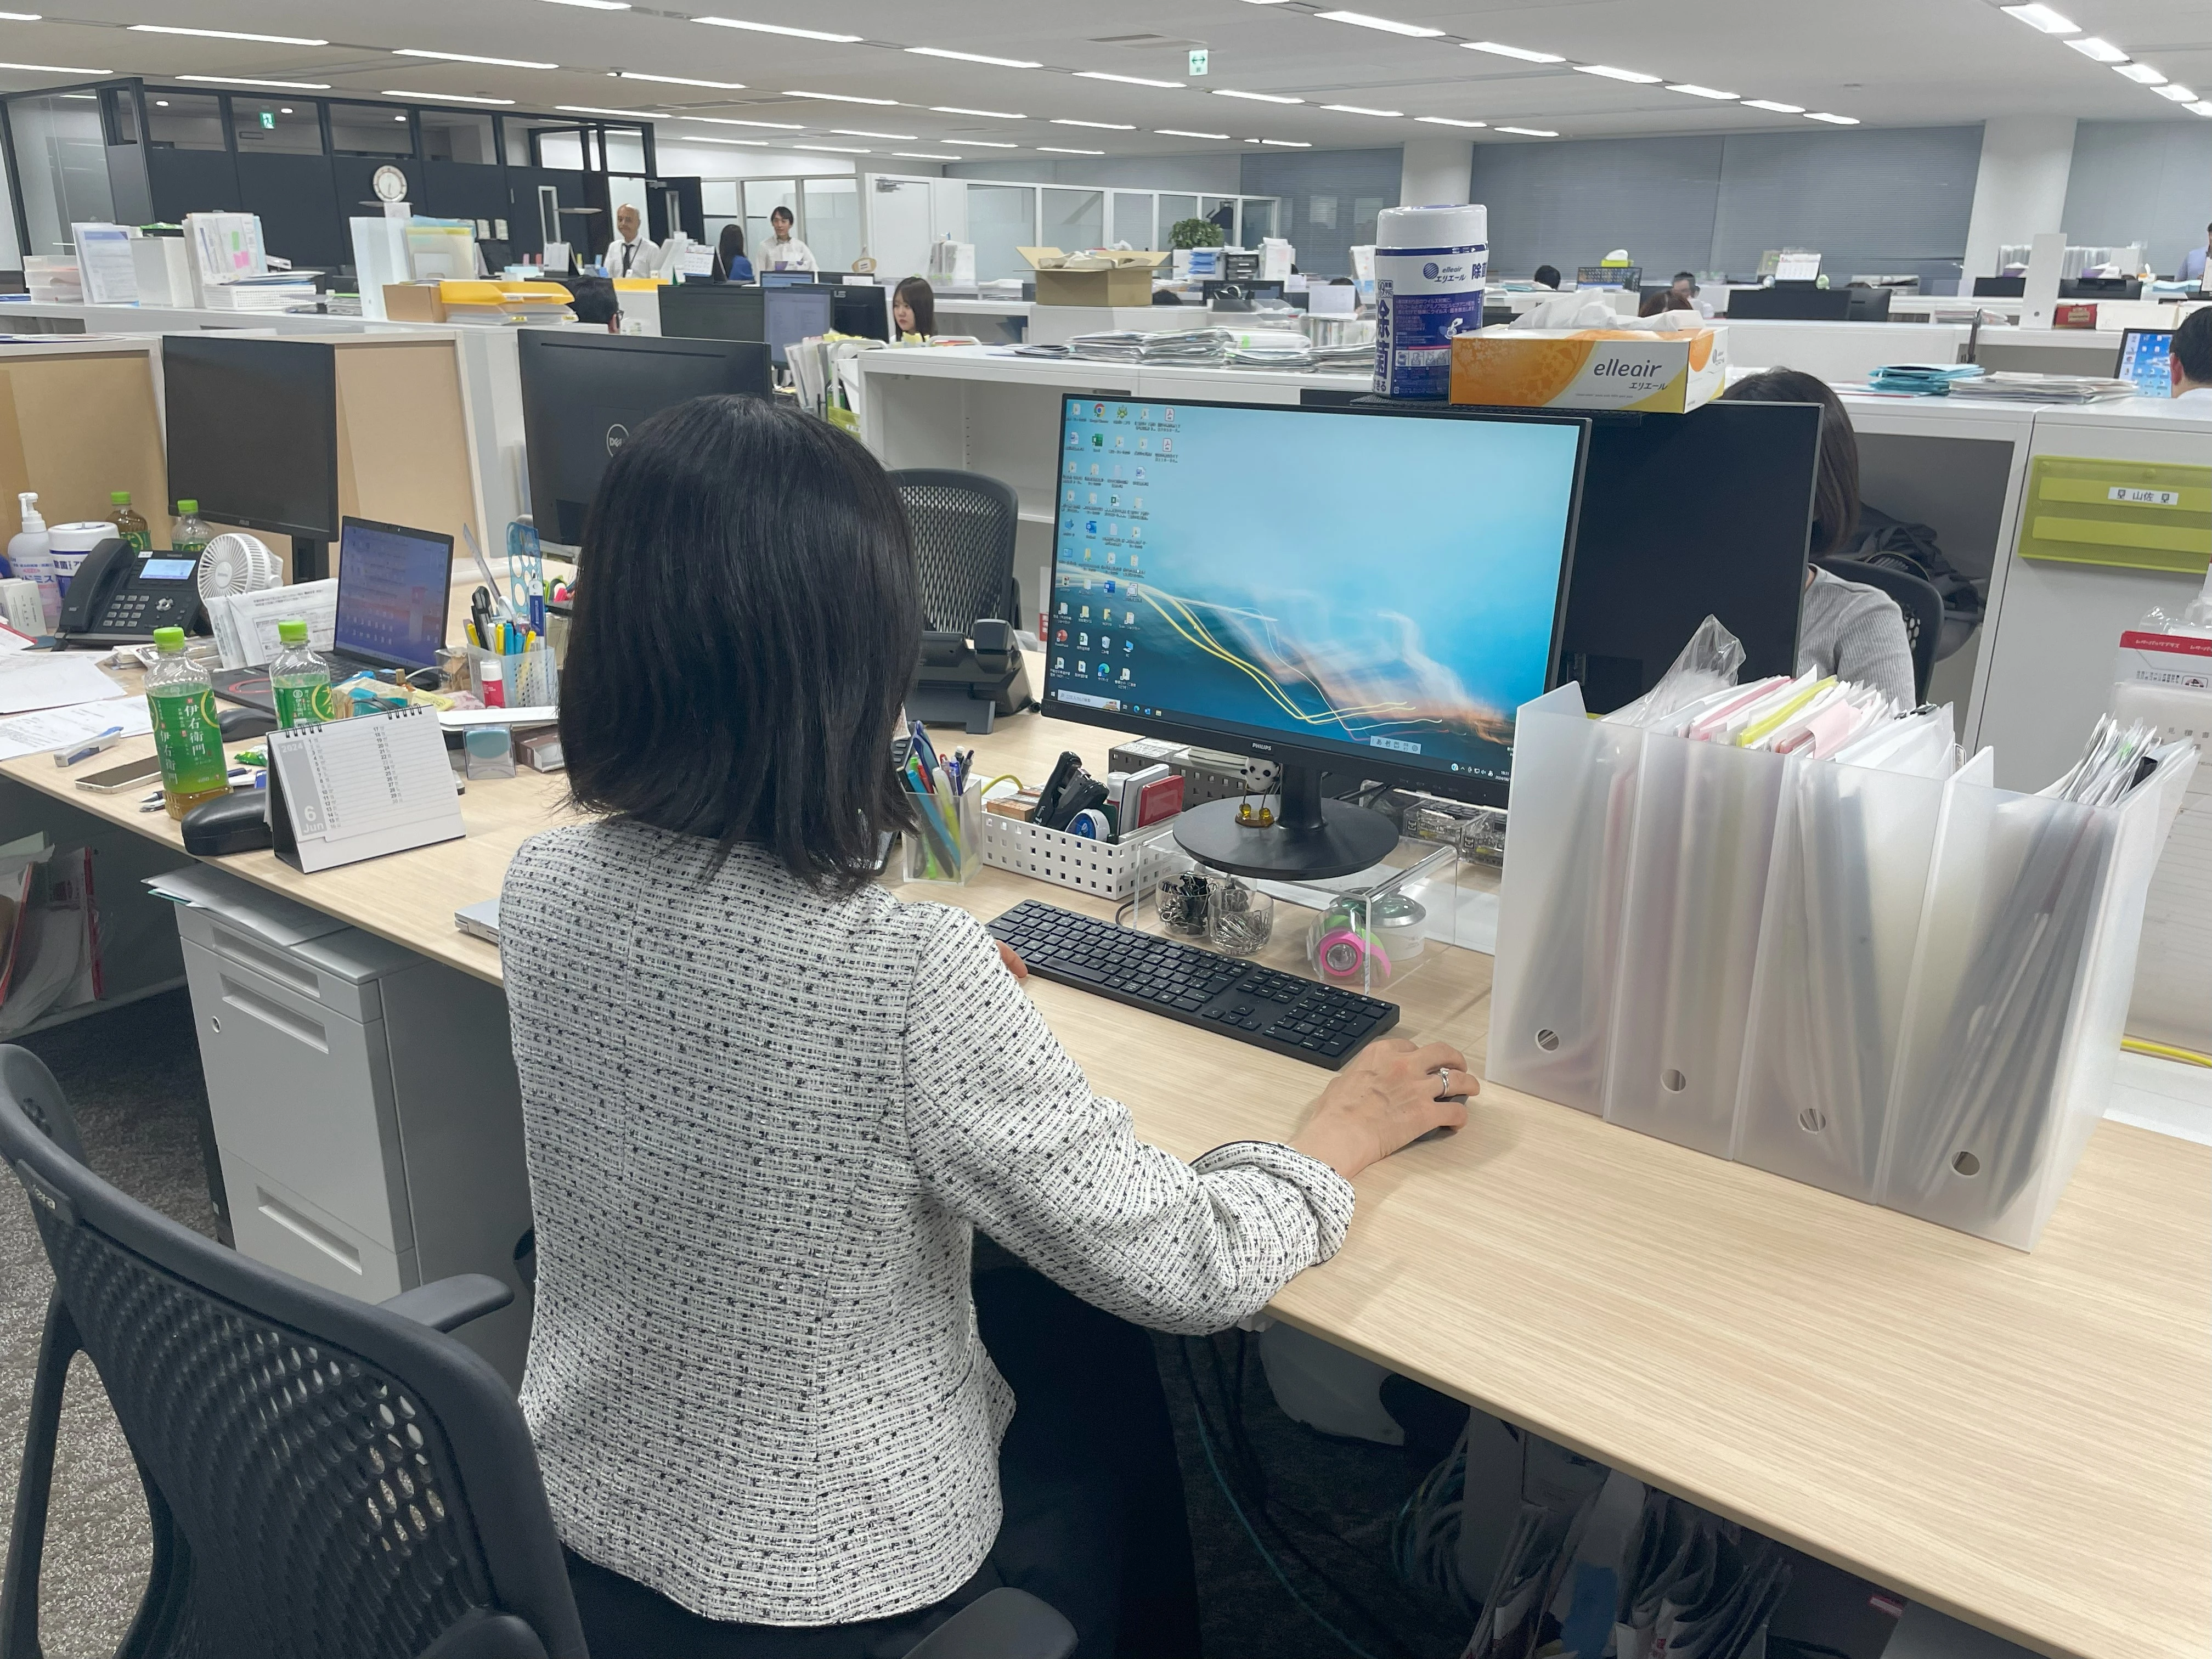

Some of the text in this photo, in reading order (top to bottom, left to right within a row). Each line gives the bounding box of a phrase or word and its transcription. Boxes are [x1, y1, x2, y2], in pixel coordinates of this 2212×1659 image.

[1434, 274, 1467, 283] エリエール
[1594, 358, 1662, 377] elleair
[1629, 382, 1668, 391] エリエール
[184, 704, 206, 756] 伊右衛門
[281, 743, 303, 753] 2024
[1252, 743, 1272, 751] PHILIPS
[304, 805, 317, 822] 6
[303, 823, 324, 833] Jun
